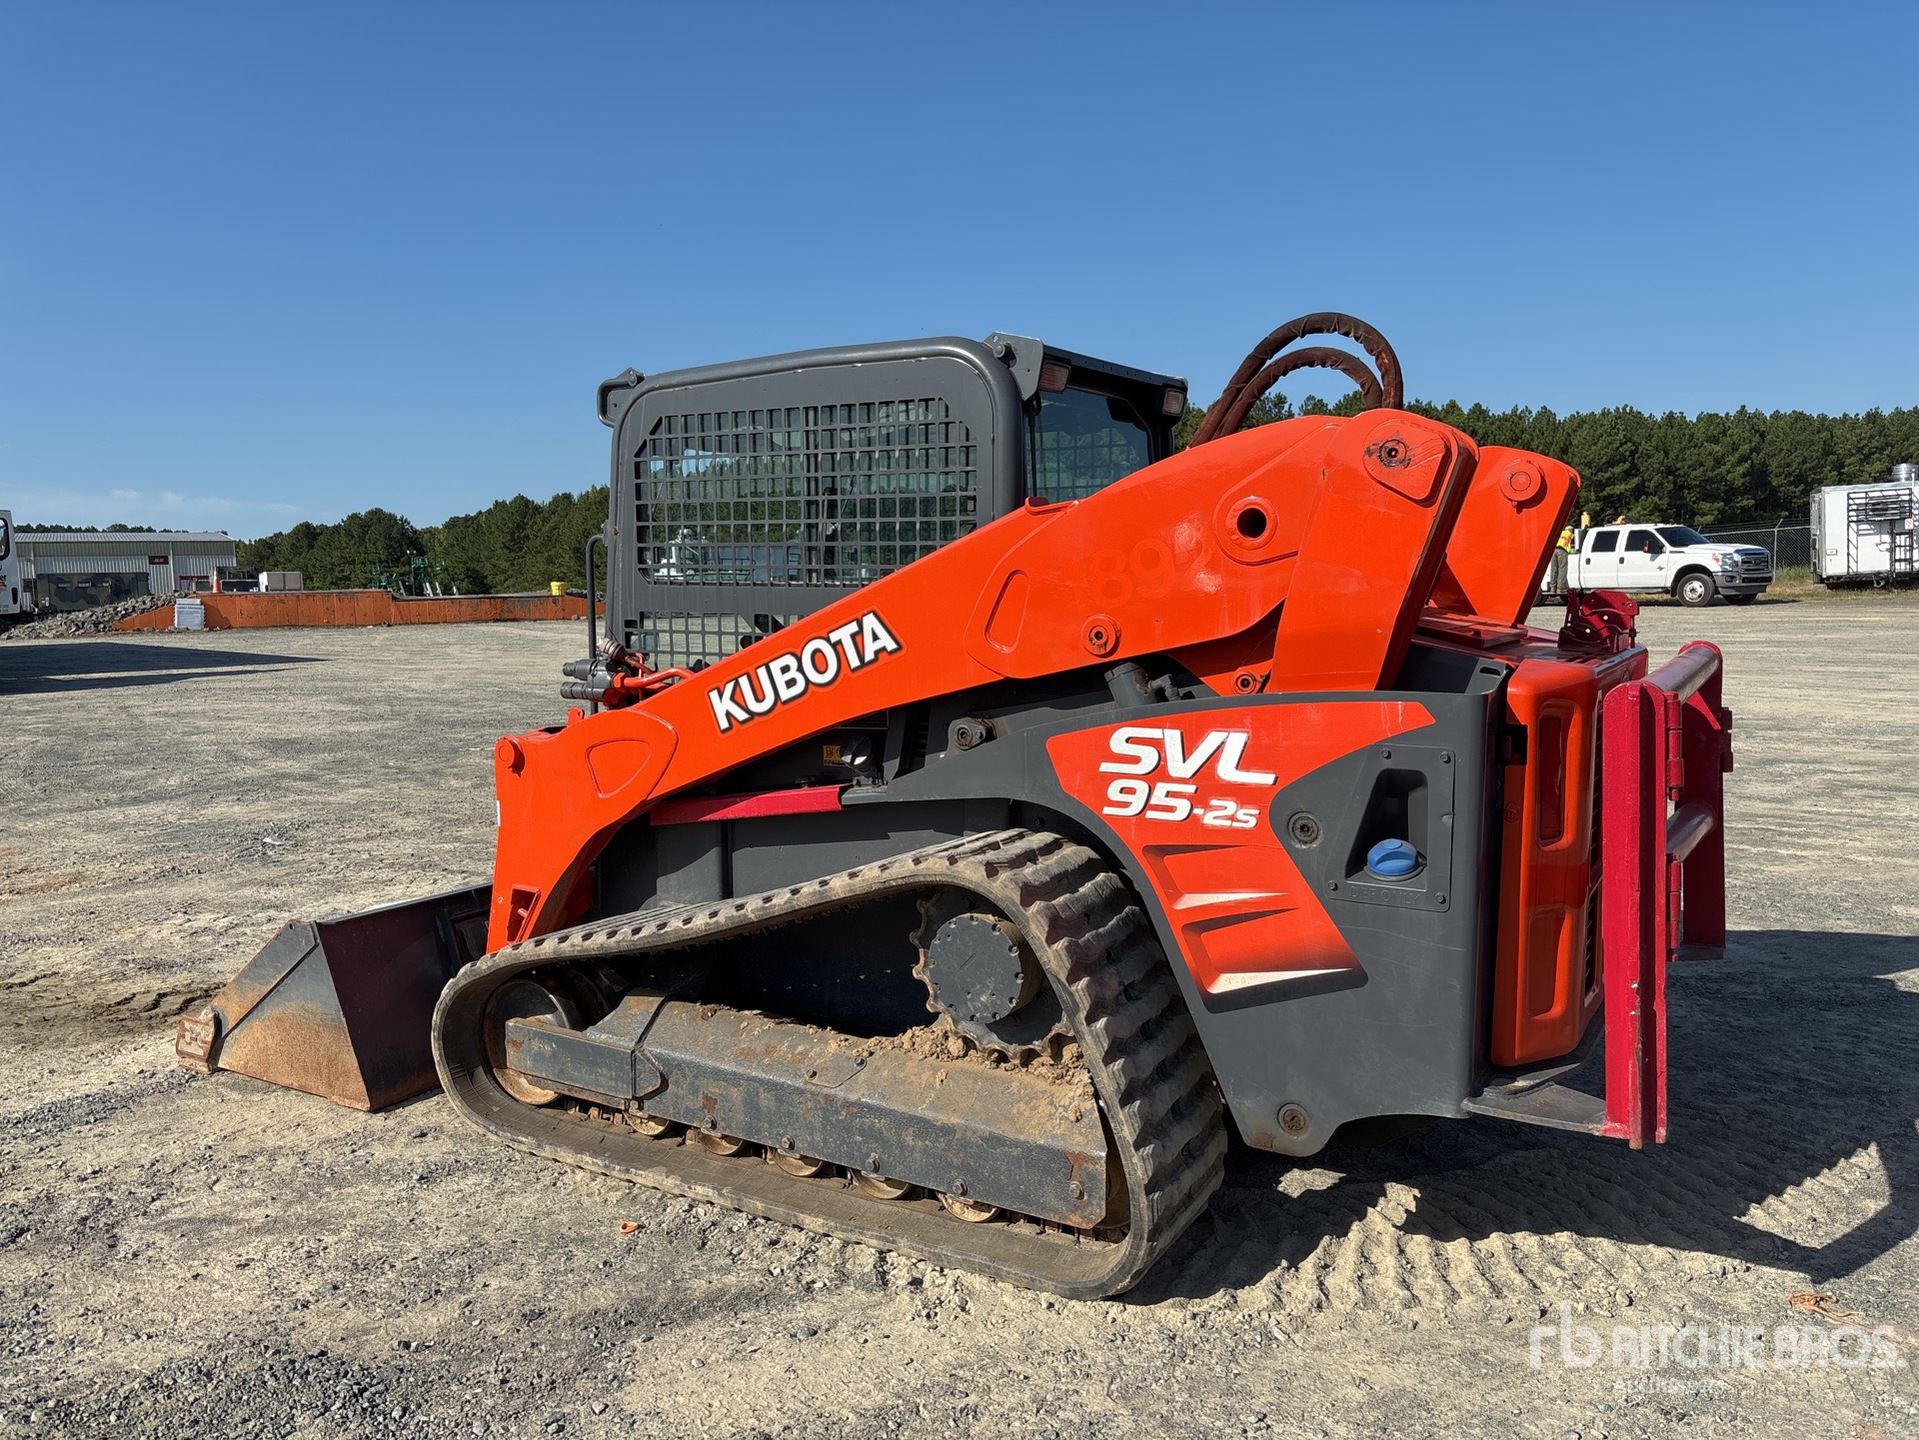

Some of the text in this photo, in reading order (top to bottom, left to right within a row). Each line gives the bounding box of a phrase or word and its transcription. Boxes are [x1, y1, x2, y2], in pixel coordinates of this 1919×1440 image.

[708, 611, 900, 733] KUBOTA
[1099, 727, 1277, 785] SVL
[1350, 885, 1421, 905] DEF ONLY
